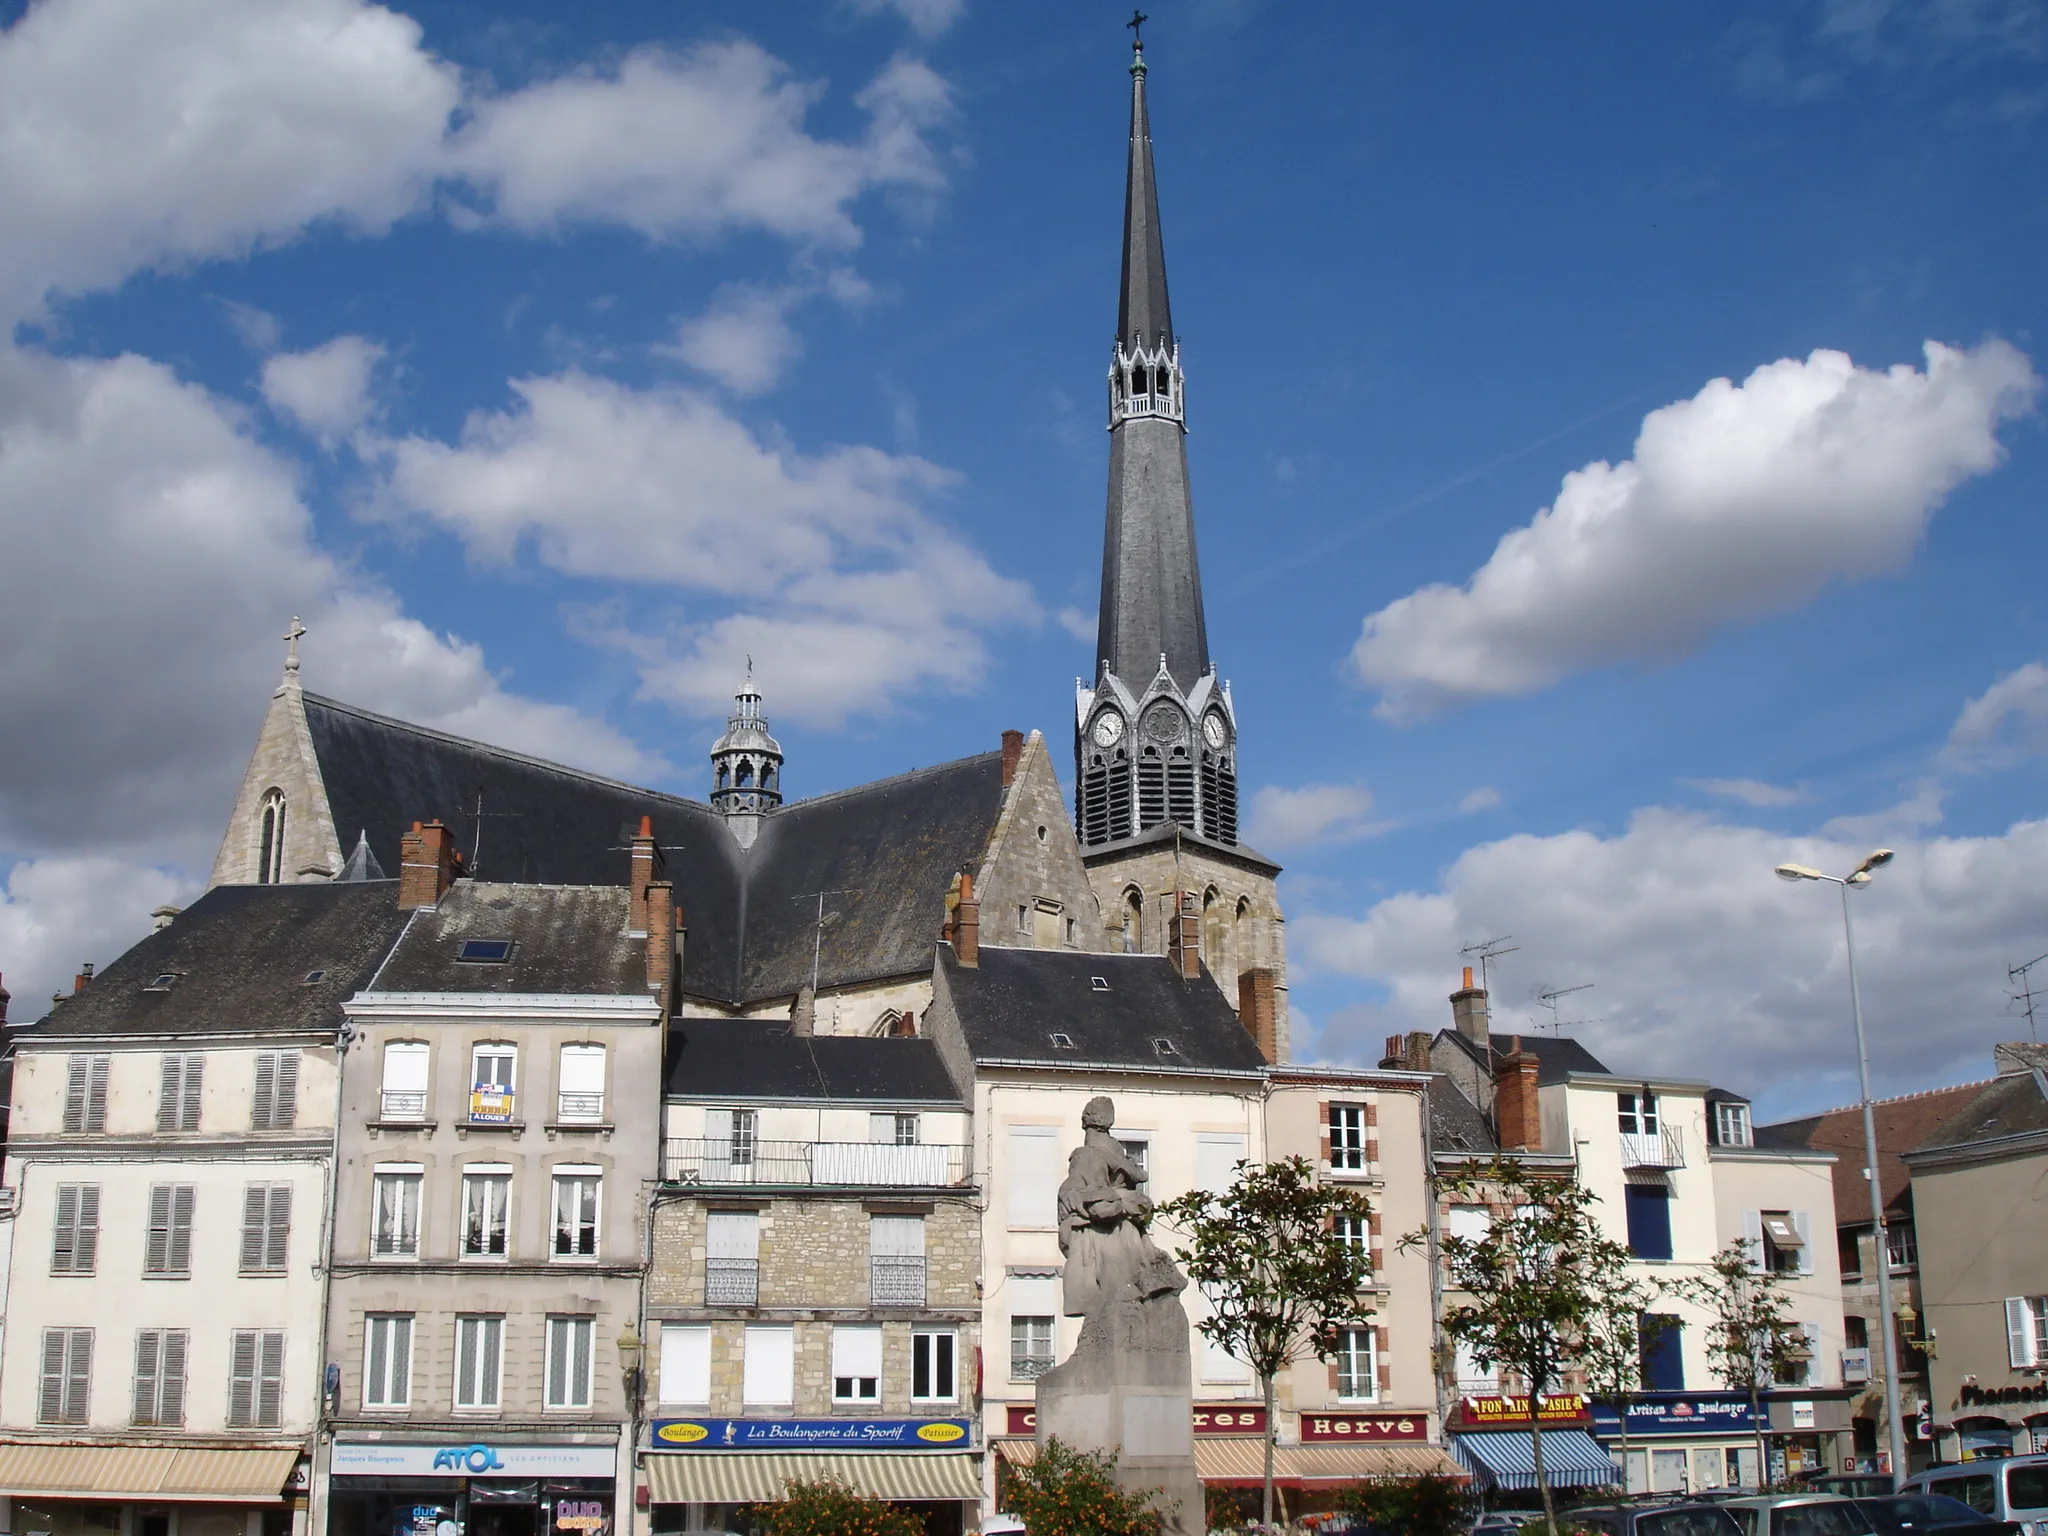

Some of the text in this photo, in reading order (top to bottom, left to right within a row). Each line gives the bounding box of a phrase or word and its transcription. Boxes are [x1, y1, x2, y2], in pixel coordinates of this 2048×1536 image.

[1627, 1403, 1667, 1416] Artisan
[1698, 1401, 1747, 1417] Boulanger
[662, 1427, 705, 1438] Boulanger
[748, 1424, 906, 1441] La Boulangerie du Sportif
[922, 1427, 959, 1438] Patissier
[1313, 1417, 1415, 1434] Hervé
[336, 1455, 366, 1464] Jacques
[433, 1444, 505, 1473] ATOL
[413, 1506, 437, 1516] duo
[557, 1501, 602, 1518] DUO
